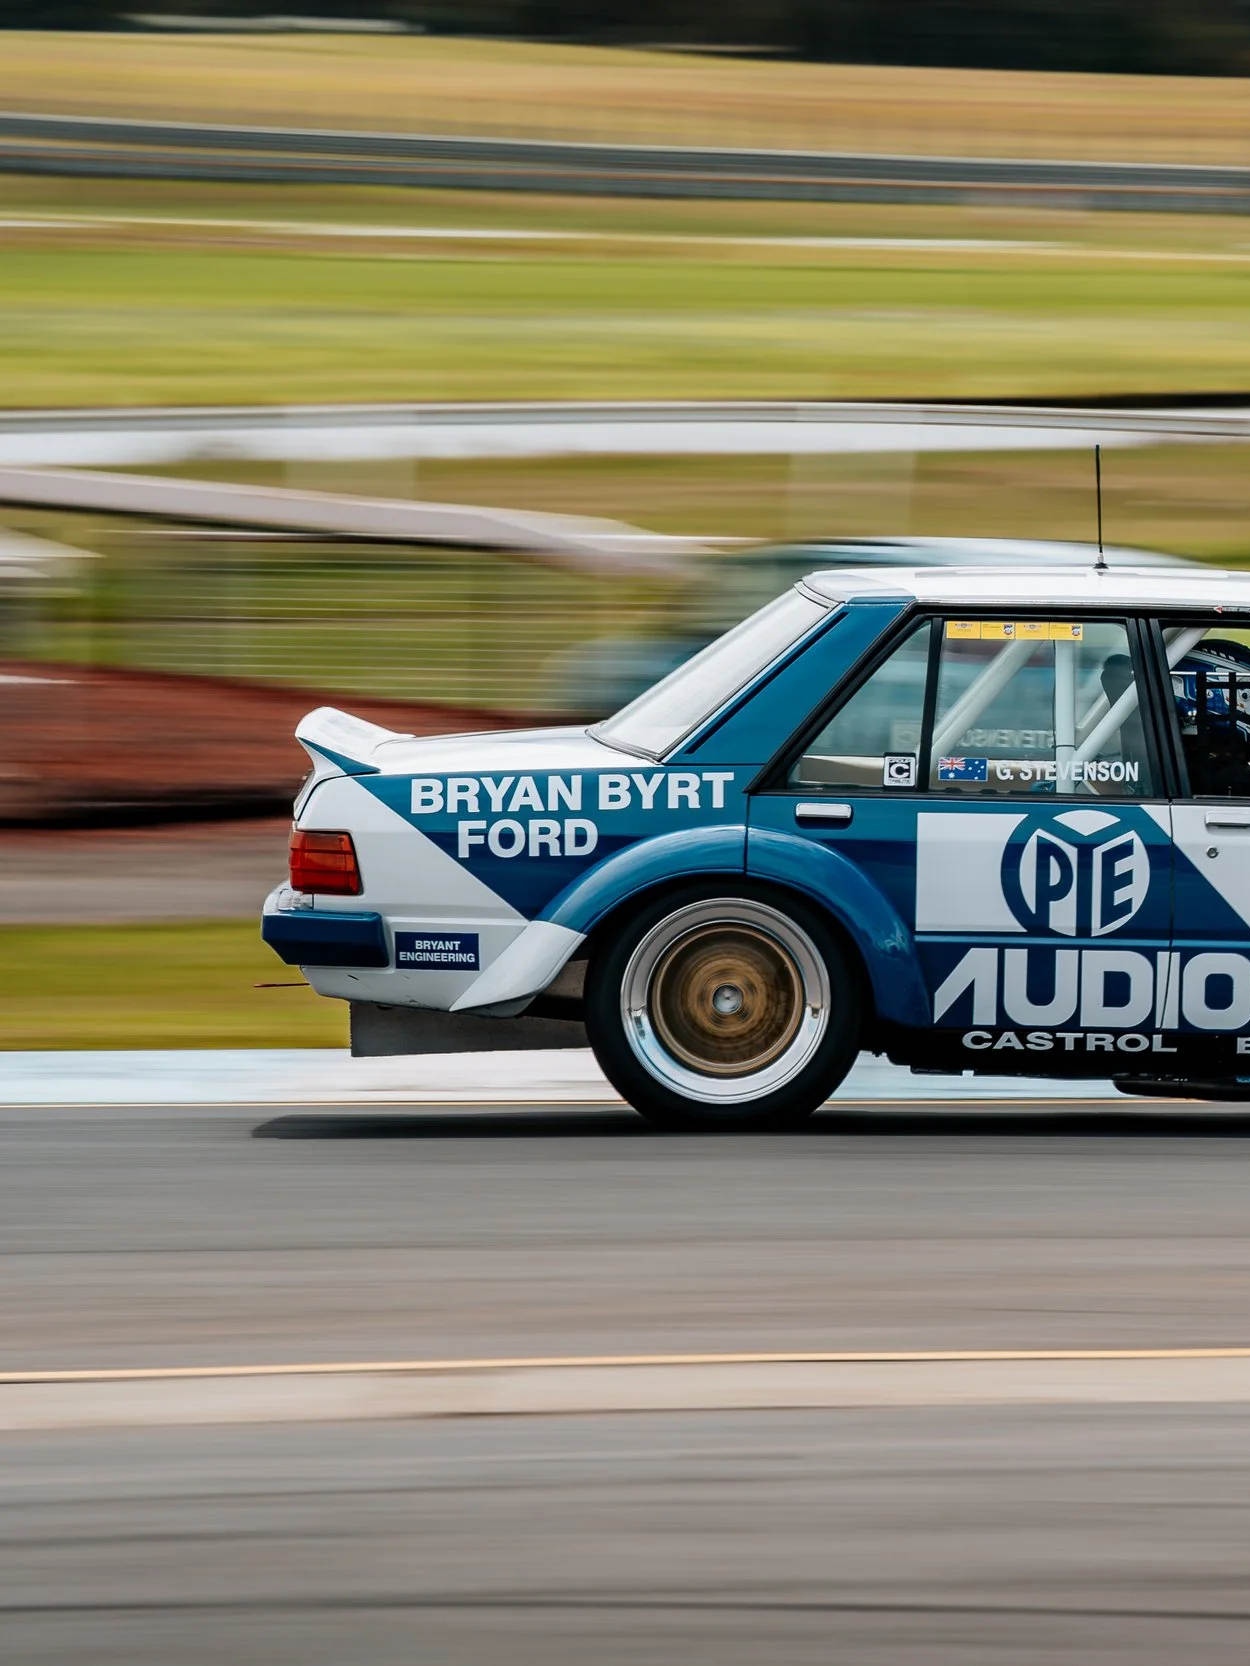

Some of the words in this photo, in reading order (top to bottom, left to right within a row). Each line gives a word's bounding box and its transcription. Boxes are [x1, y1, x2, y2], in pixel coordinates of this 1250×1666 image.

[890, 763, 910, 778] C
[996, 762, 1014, 780] G.
[1019, 761, 1139, 782] STEVENSON
[410, 774, 582, 813] BRYAN
[598, 771, 734, 809] BYRT
[457, 818, 599, 858] FORD
[415, 940, 461, 950] BRYANT
[399, 951, 476, 963] ENGINEERING
[961, 1031, 1178, 1053] CASTROL
